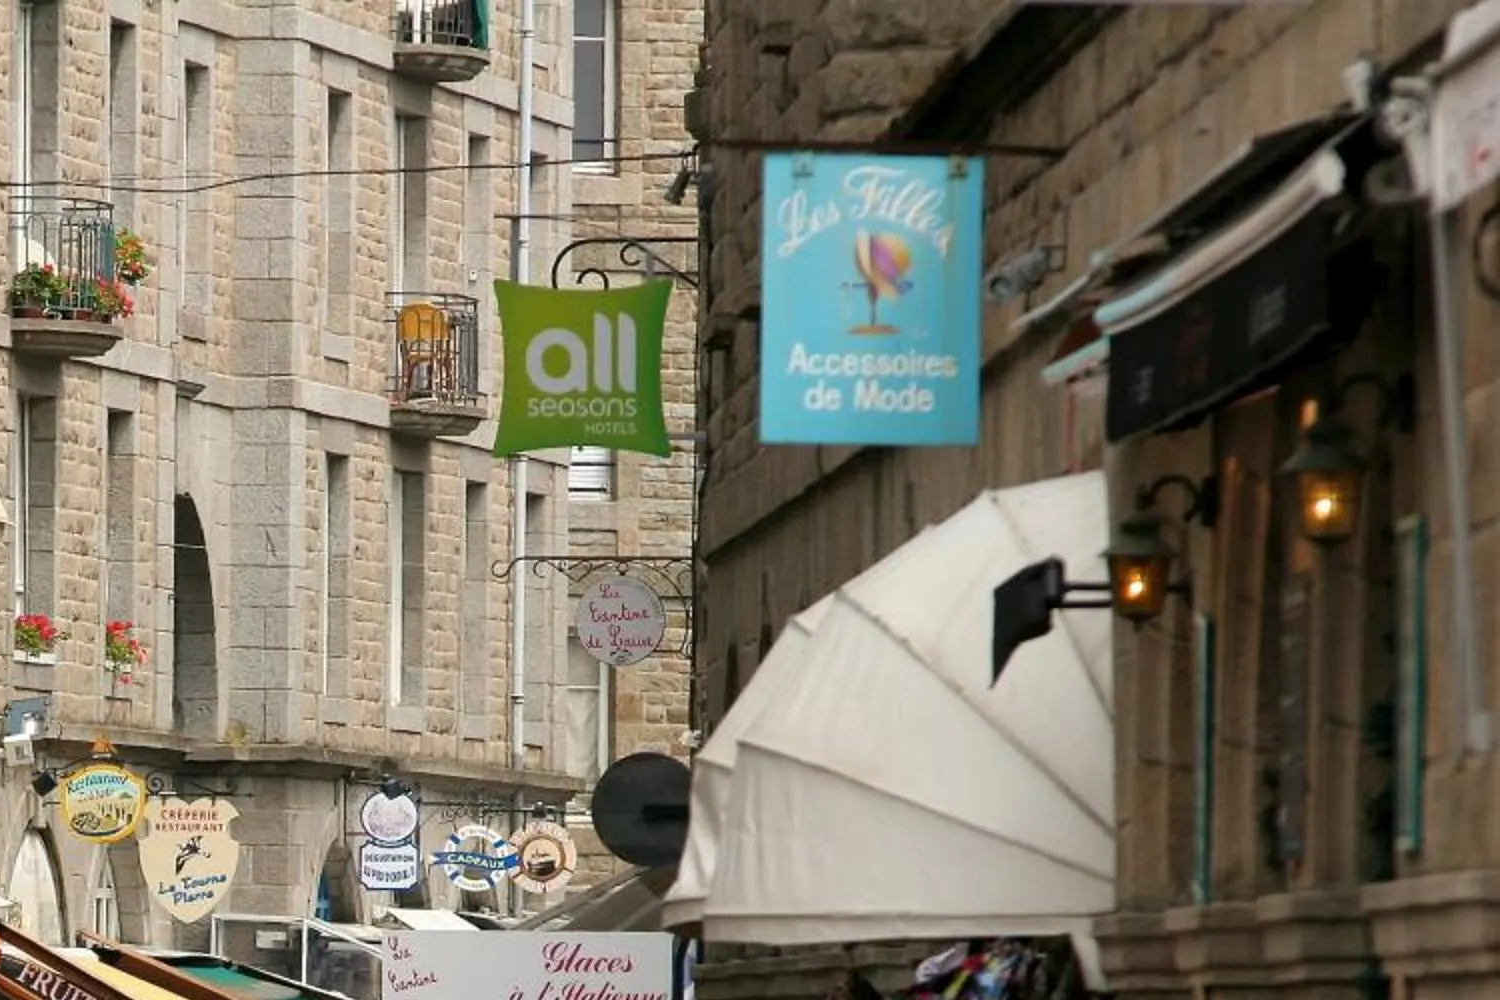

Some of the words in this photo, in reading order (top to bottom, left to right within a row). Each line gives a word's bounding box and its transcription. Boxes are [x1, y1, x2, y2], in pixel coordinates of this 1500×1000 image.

[777, 189, 842, 257] Les
[843, 163, 956, 258] Filles
[525, 311, 637, 395] all
[786, 342, 959, 378] Accessoires
[527, 397, 637, 418] seasons
[803, 379, 842, 411] de
[853, 380, 935, 412] Mode
[585, 422, 637, 435] HOTELS
[447, 853, 505, 869] CADEAUX
[542, 941, 634, 973] Glaces
